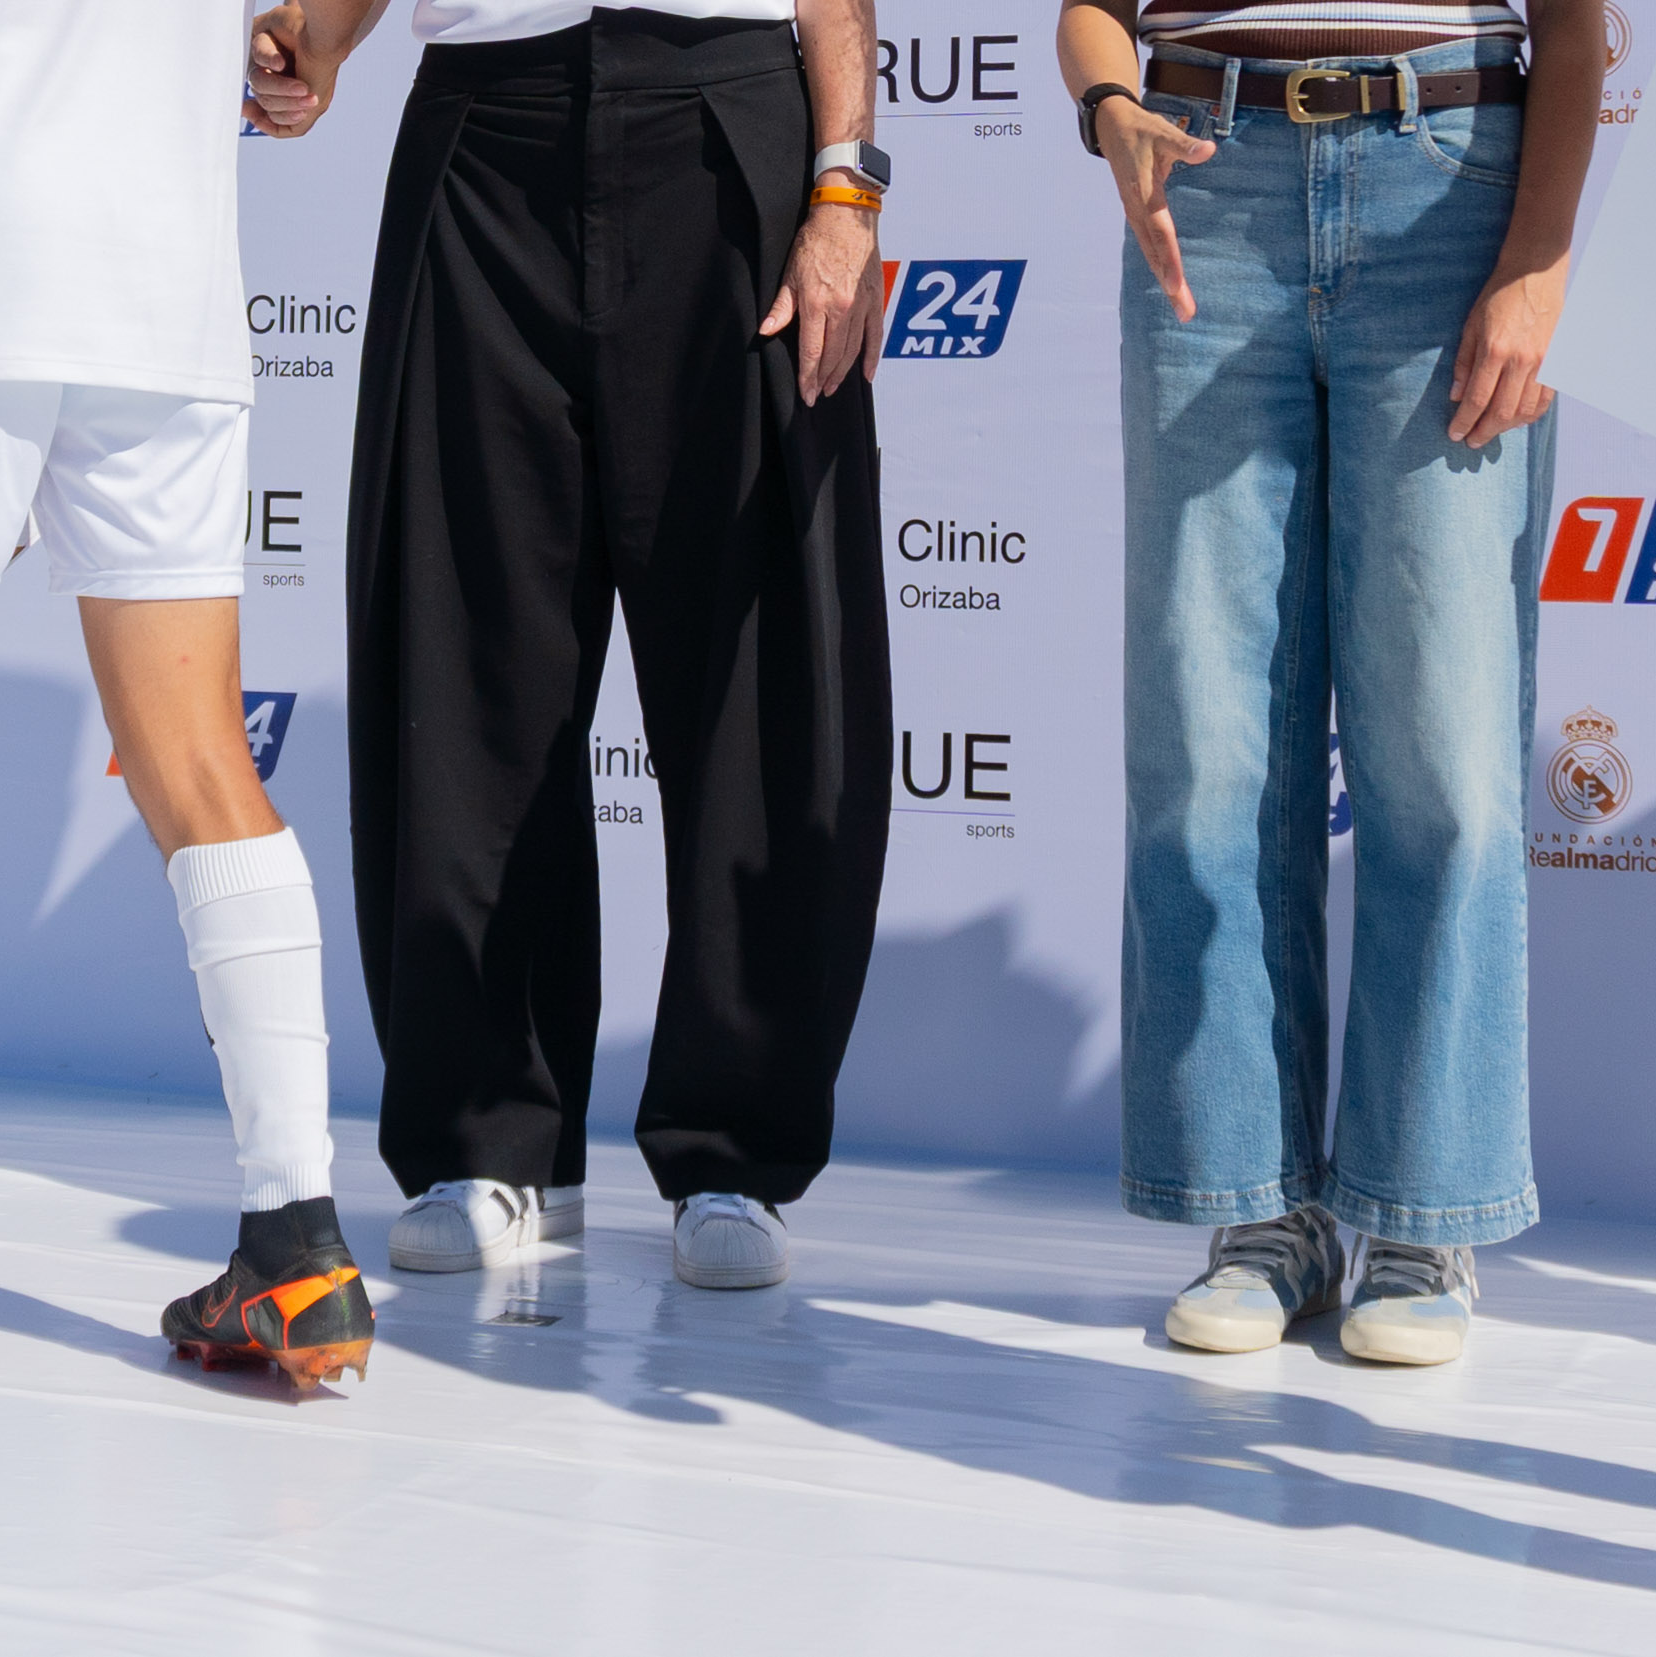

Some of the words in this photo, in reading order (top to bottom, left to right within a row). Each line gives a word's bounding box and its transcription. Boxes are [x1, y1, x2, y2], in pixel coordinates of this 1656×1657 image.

[877, 35, 1018, 103] RUE
[974, 122, 1022, 139] sports
[247, 294, 356, 334] Clinic
[908, 271, 1003, 329] 24
[900, 337, 986, 355] MIX
[898, 519, 1025, 563] Clinic
[263, 574, 304, 588] sports
[900, 584, 1000, 610] Orizaba
[902, 731, 1011, 802] UE
[966, 824, 1014, 839] sports
